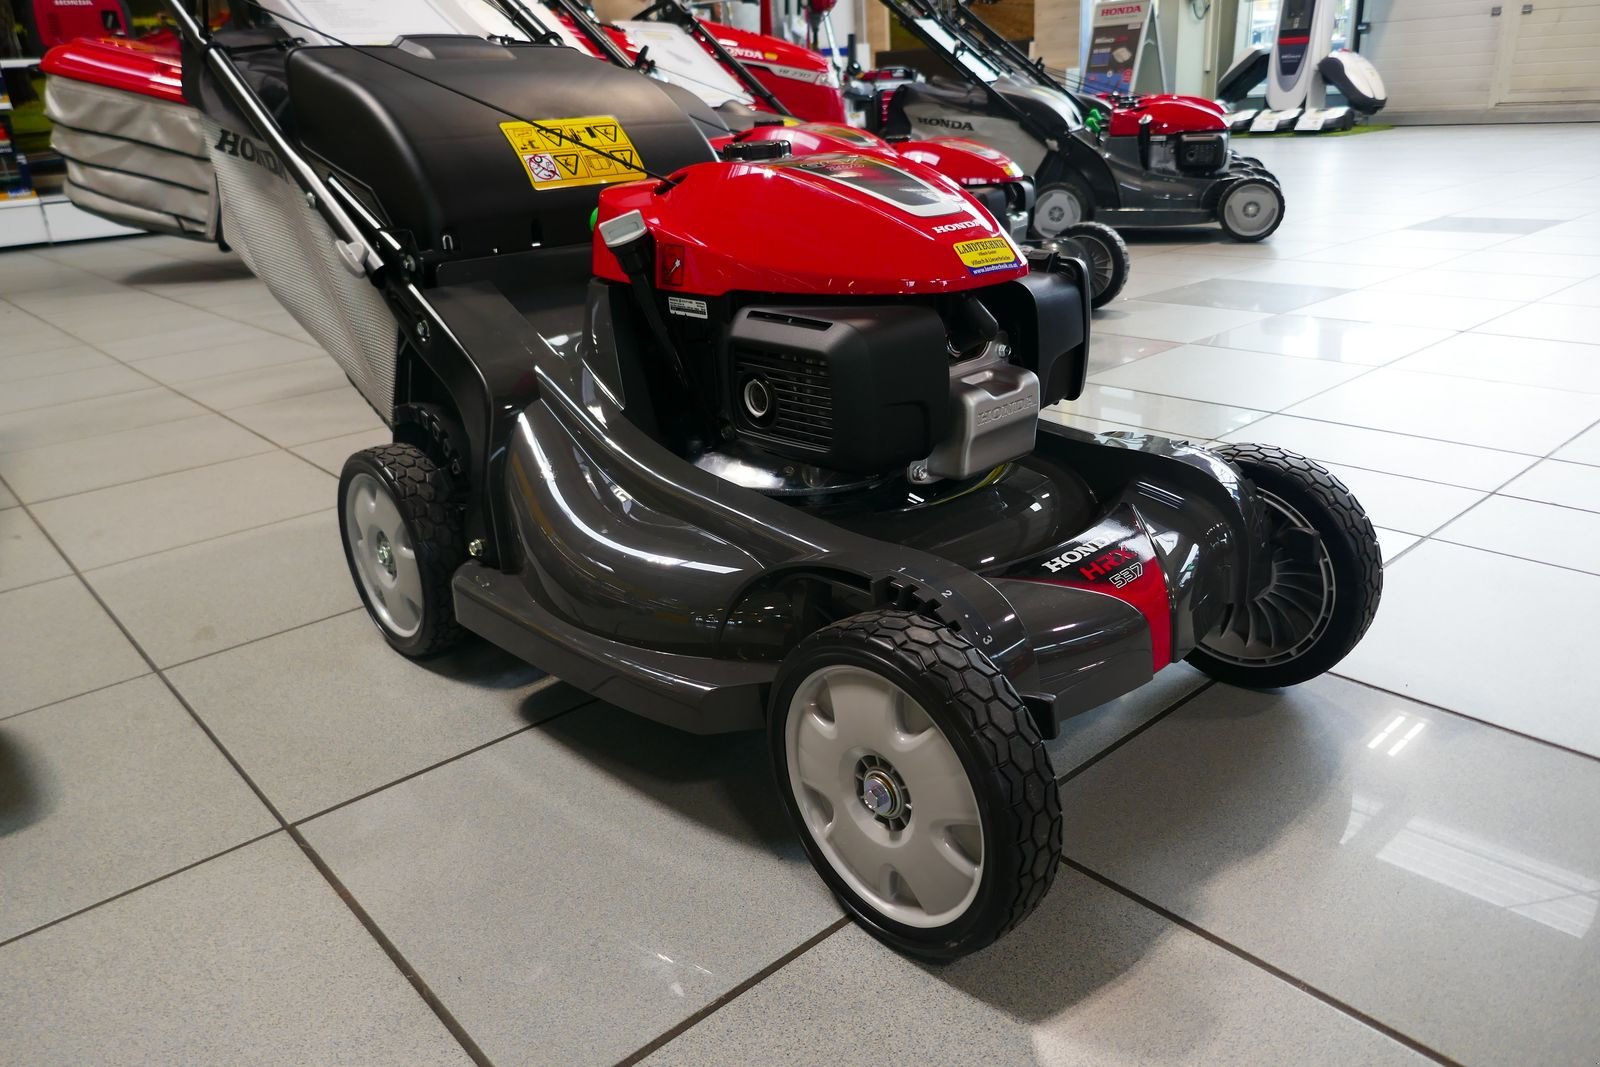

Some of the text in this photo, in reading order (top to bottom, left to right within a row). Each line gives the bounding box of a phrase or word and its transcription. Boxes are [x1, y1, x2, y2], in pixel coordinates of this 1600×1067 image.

[1101, 5, 1142, 17] HONDA
[724, 46, 764, 60] ONDA
[917, 117, 974, 132] HONDA
[932, 220, 982, 233] HONDA
[956, 240, 1007, 254] LANDTECHNIK
[977, 394, 1037, 427] HONDA
[1079, 544, 1139, 581] HRX
[1108, 561, 1143, 589] 537
[940, 589, 953, 599] 2
[982, 634, 993, 645] 3
